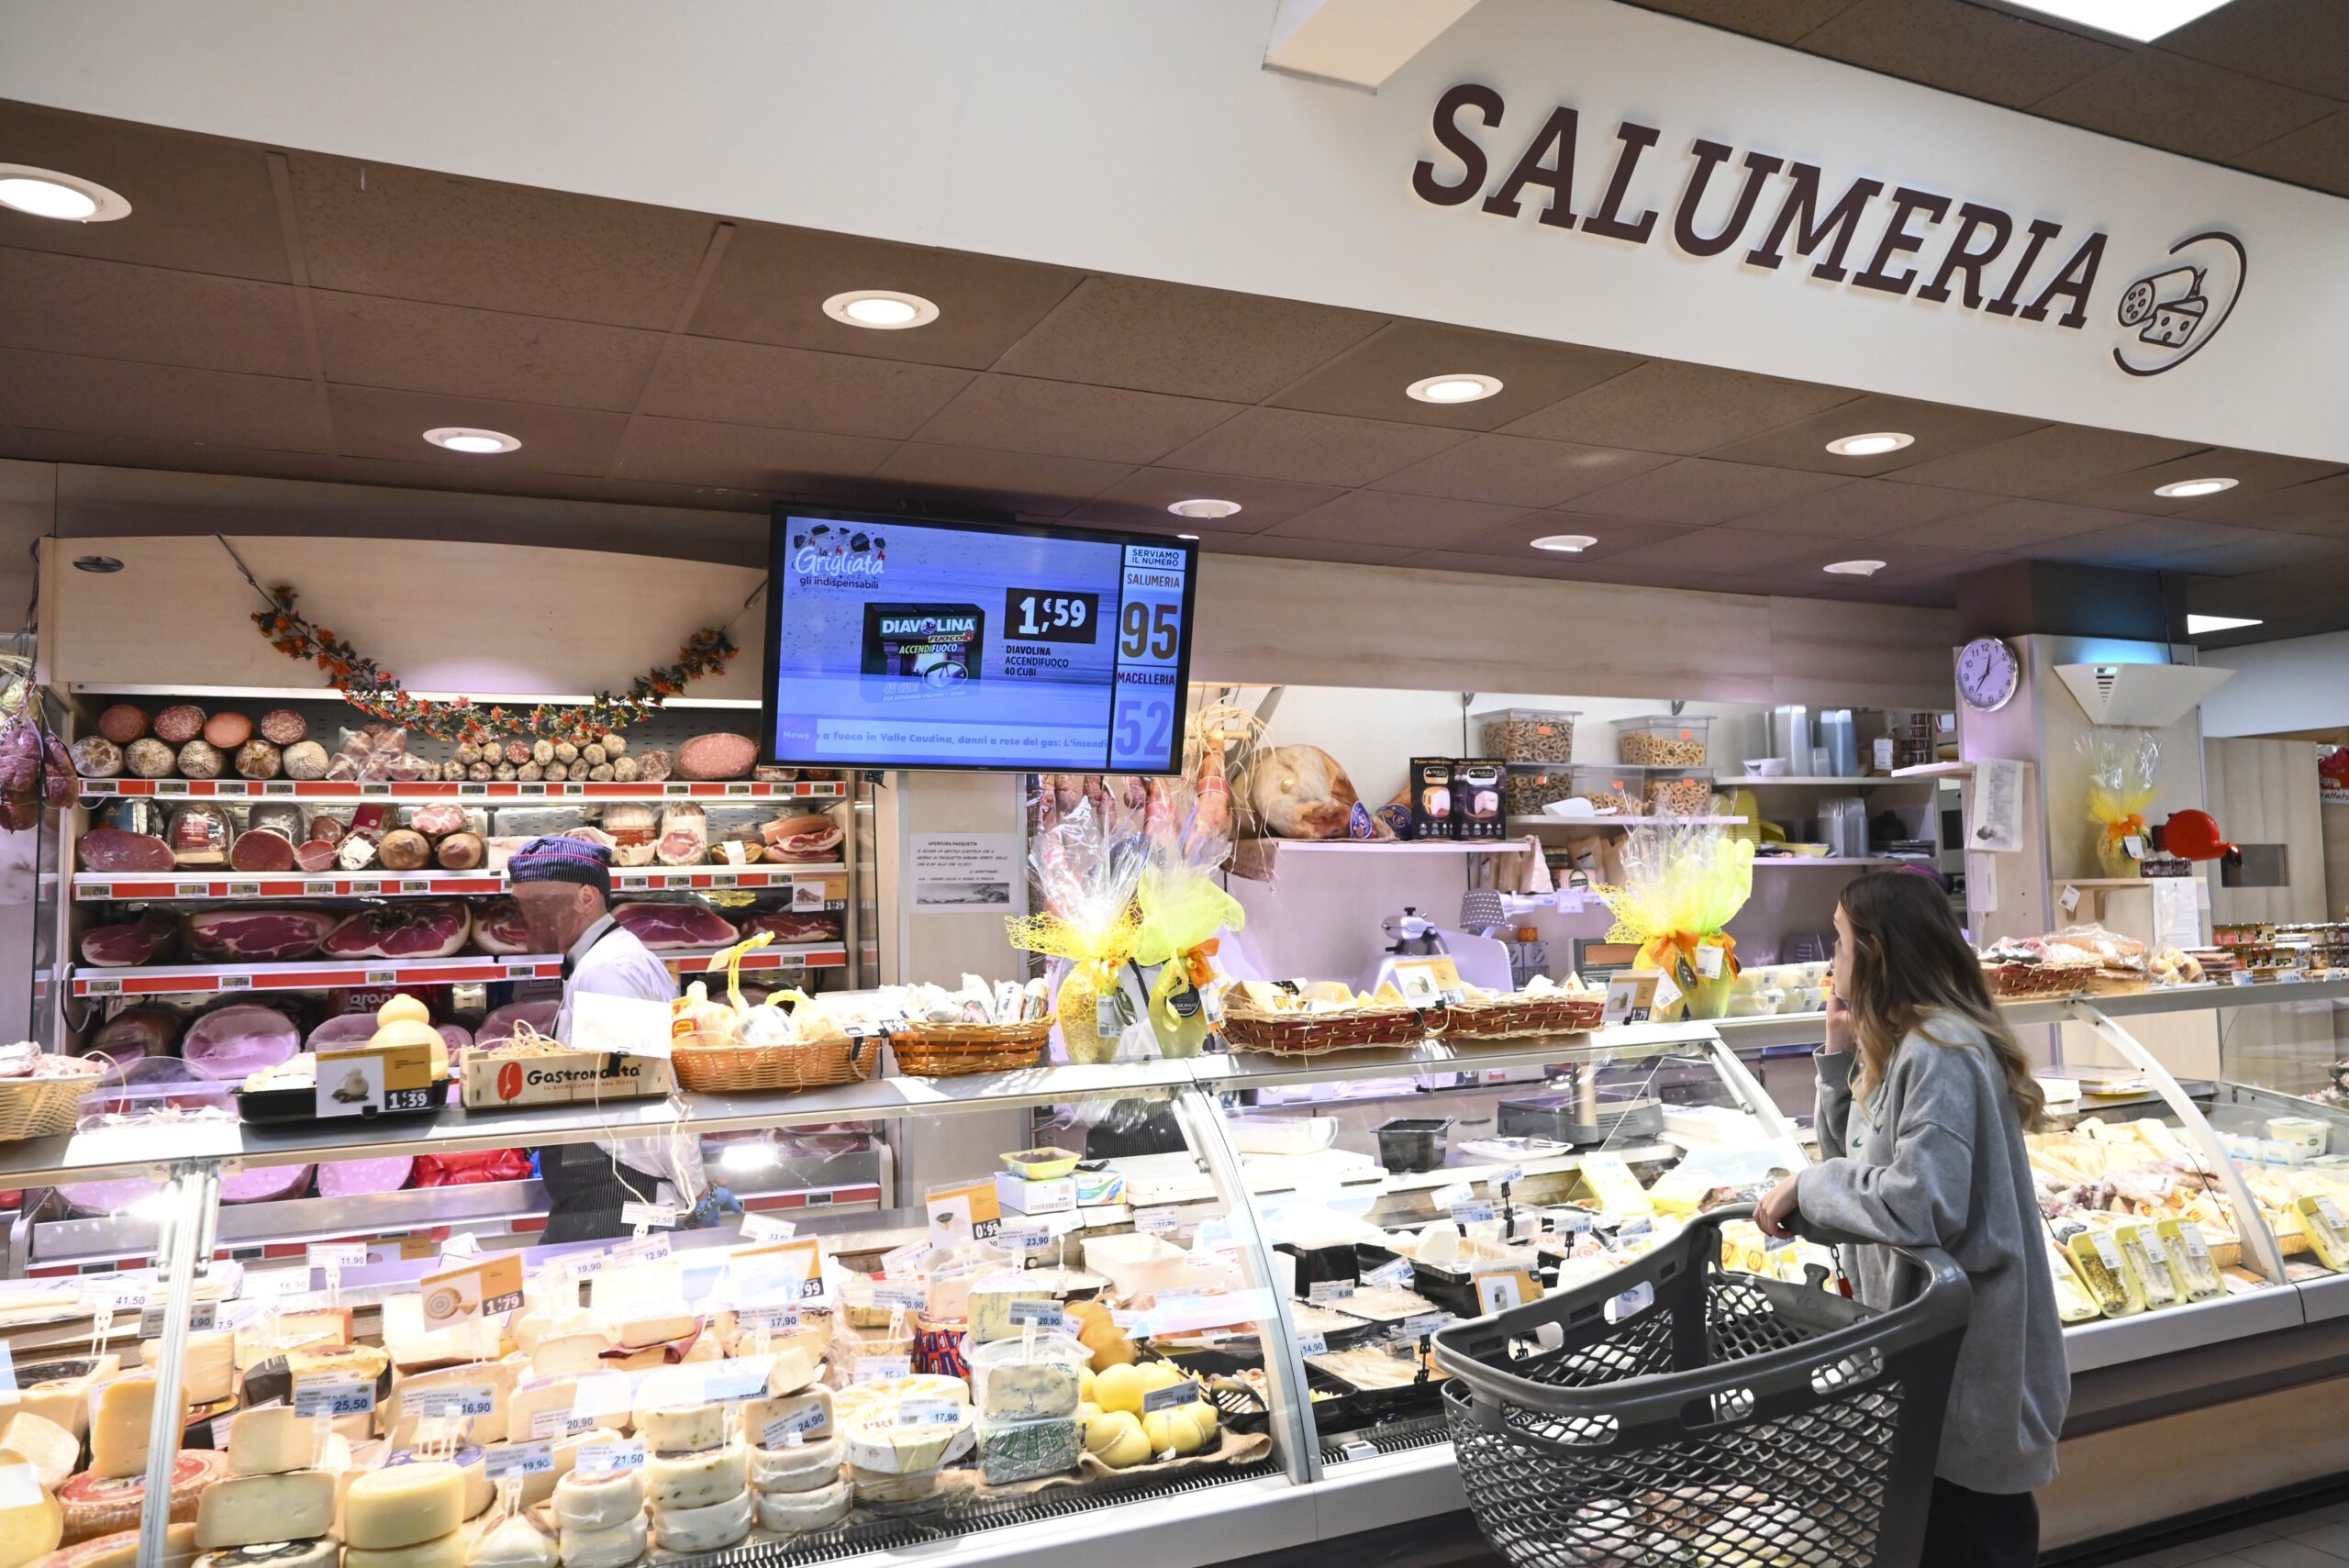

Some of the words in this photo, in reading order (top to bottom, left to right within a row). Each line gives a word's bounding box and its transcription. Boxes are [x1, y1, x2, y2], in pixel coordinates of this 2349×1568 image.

[1412, 83, 2109, 329] SALUMERIA
[819, 547, 828, 556] la
[1132, 549, 1180, 560] SERVIAMO
[795, 546, 885, 576] Grigliata
[1142, 557, 1179, 566] NUMERO
[800, 576, 812, 586] gli
[814, 577, 879, 589] indispensabili
[1127, 573, 1180, 588] SALUMERIA
[1121, 601, 1178, 659] 95
[899, 643, 958, 654] ACCENDIFUOCO
[1006, 645, 1052, 656] DIAVOLINA
[1981, 642, 1990, 652] 12
[1995, 644, 1998, 652] 1
[1972, 649, 1979, 658] 11
[2002, 652, 2008, 662] 2
[1005, 656, 1069, 668] ACCENDIFUOCO
[1965, 660, 1973, 669] 10
[1005, 667, 1015, 675] 40
[1017, 668, 1036, 676] CUBI
[2007, 664, 2012, 673] 3
[1118, 673, 1175, 686] MACELLERIA
[1964, 673, 1969, 682] 9
[2006, 678, 2010, 686] 4
[1968, 685, 1974, 694] 8
[1998, 690, 2004, 698] 5
[1977, 693, 1982, 701] 7
[1988, 695, 1994, 704] 6
[1115, 701, 1171, 755] 52
[784, 730, 809, 740] News
[833, 731, 863, 741] fuoco
[867, 731, 877, 741] in
[881, 733, 907, 742] Valle
[909, 734, 955, 745] Caudina,
[958, 736, 988, 745] danni
[1000, 738, 1020, 746] rete
[1023, 737, 1039, 747] del
[1041, 739, 1062, 749] gas:
[1026, 1237, 1049, 1246] 23,90
[340, 1256, 364, 1265] 11,90
[577, 1262, 602, 1273] 19,90
[1338, 1289, 1353, 1298] 6,90
[116, 1296, 146, 1307] 41,50
[771, 1316, 796, 1327] 17,90
[334, 1399, 368, 1412] 25,50
[462, 1402, 491, 1414] 16,90
[797, 1413, 825, 1432] 24,90
[935, 1413, 958, 1422] 17,90
[566, 1418, 594, 1430] 20,90
[613, 1453, 643, 1465] 21,50
[523, 1459, 549, 1471] 19,90
